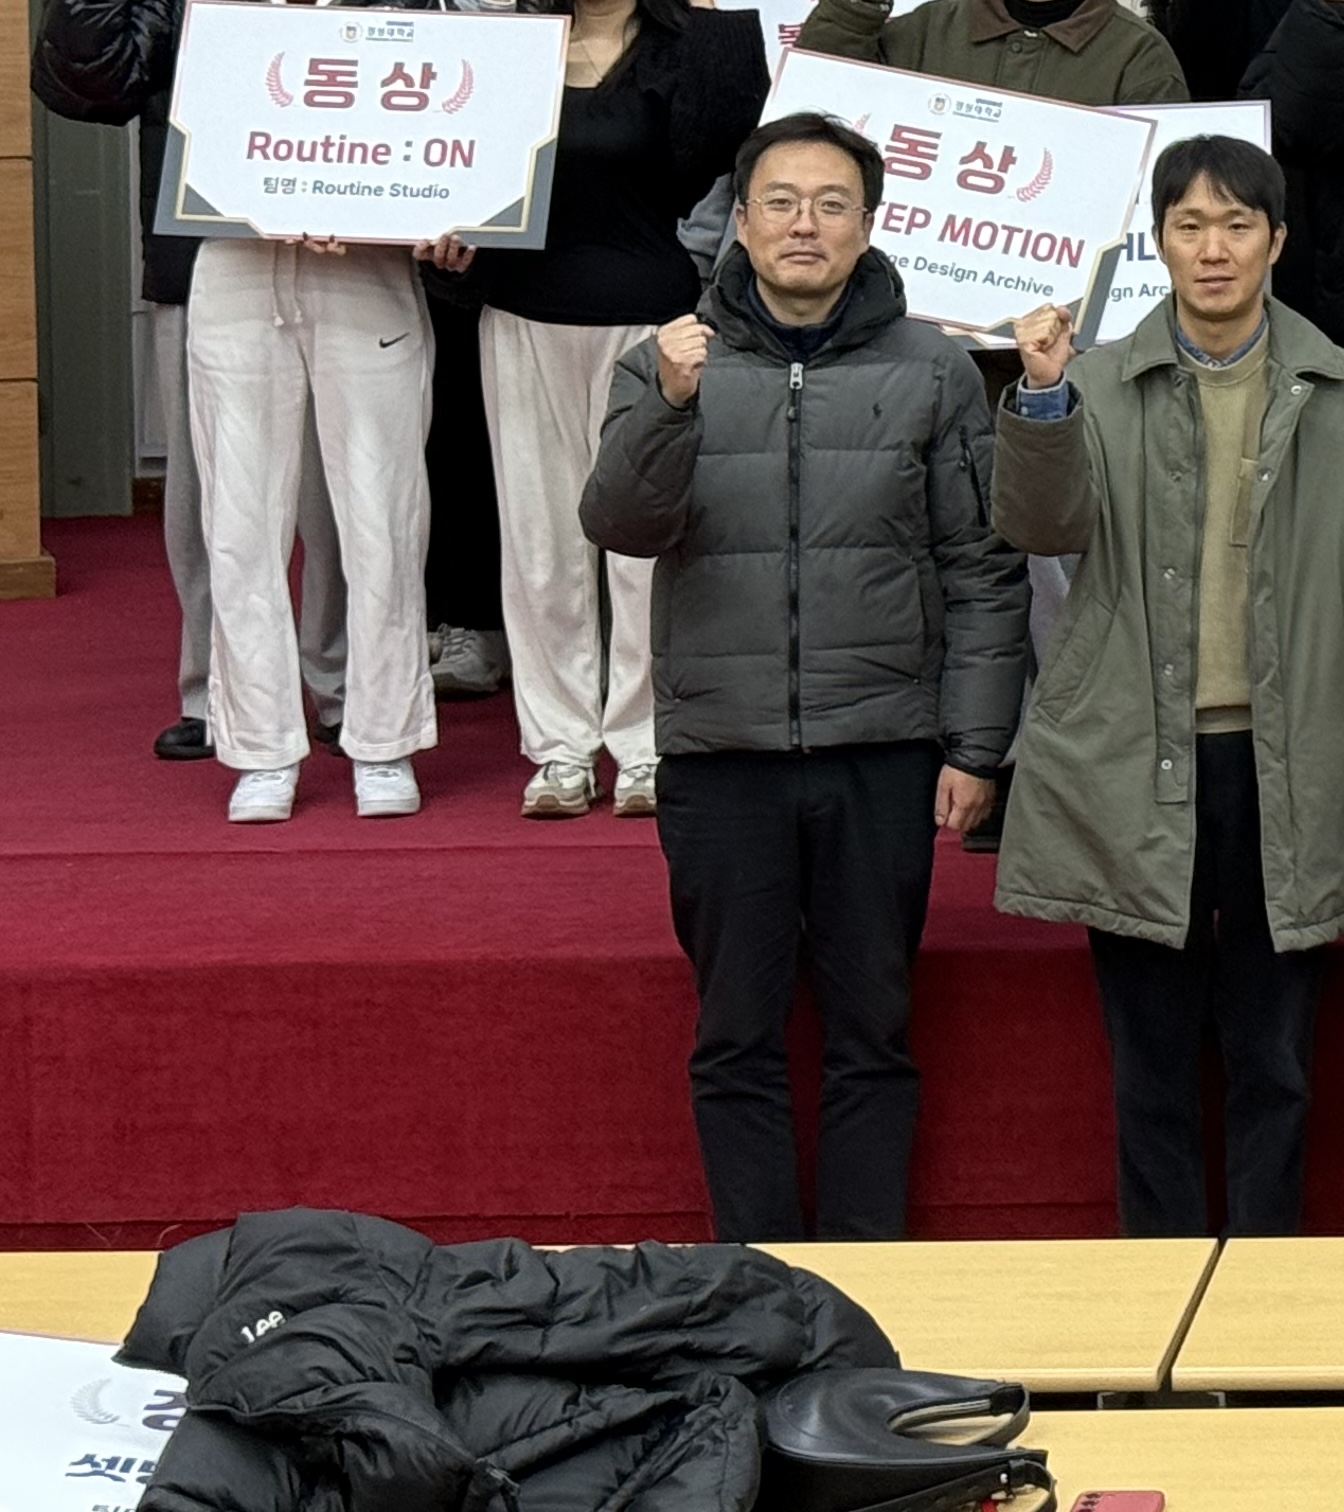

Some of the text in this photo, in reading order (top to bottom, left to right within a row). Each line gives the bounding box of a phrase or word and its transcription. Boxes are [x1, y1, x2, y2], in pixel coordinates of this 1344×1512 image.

[246, 131, 392, 166] Routine
[424, 138, 476, 168] ON
[263, 177, 297, 195] 팀명
[312, 180, 384, 197] Routine
[389, 183, 450, 199] Studio
[937, 214, 1085, 268] MOTION
[914, 257, 978, 283] Design
[983, 270, 1054, 296] Archive
